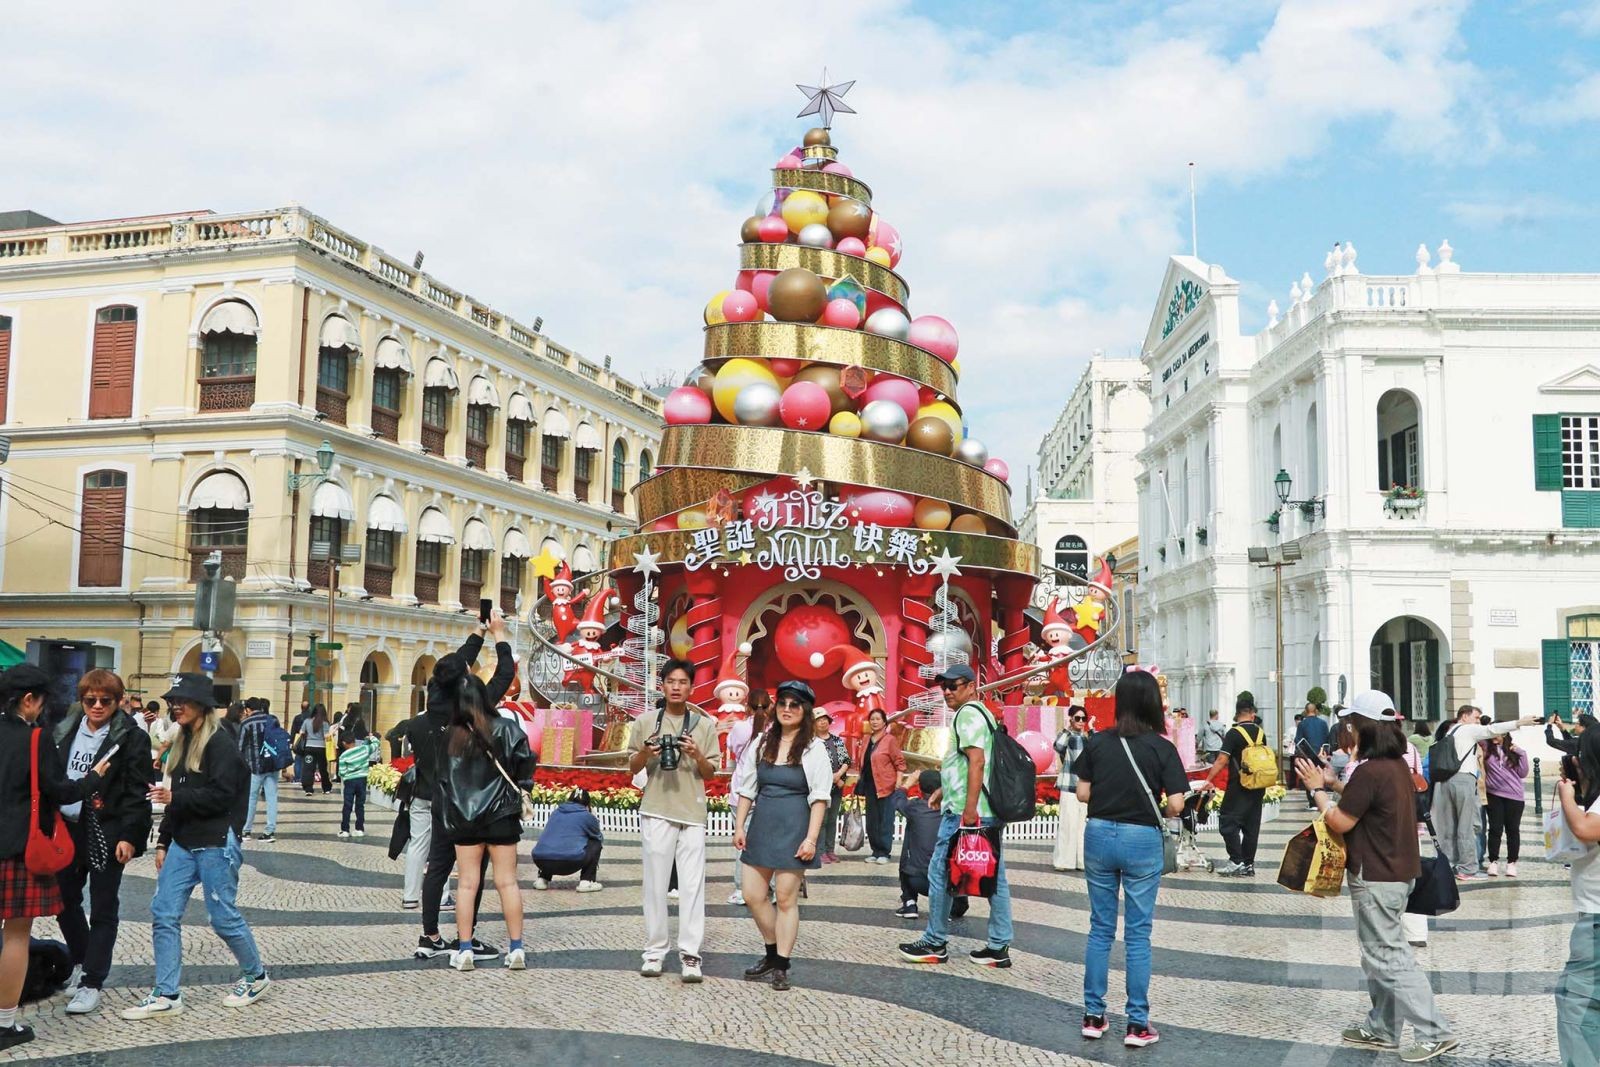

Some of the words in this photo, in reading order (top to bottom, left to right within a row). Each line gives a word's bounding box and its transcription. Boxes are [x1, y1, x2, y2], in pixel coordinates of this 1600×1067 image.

[685, 519, 756, 572] 聖誕
[853, 520, 928, 575] 快樂
[757, 529, 851, 582] NATAL
[1057, 562, 1086, 570] PISA
[73, 751, 93, 763] LOV
